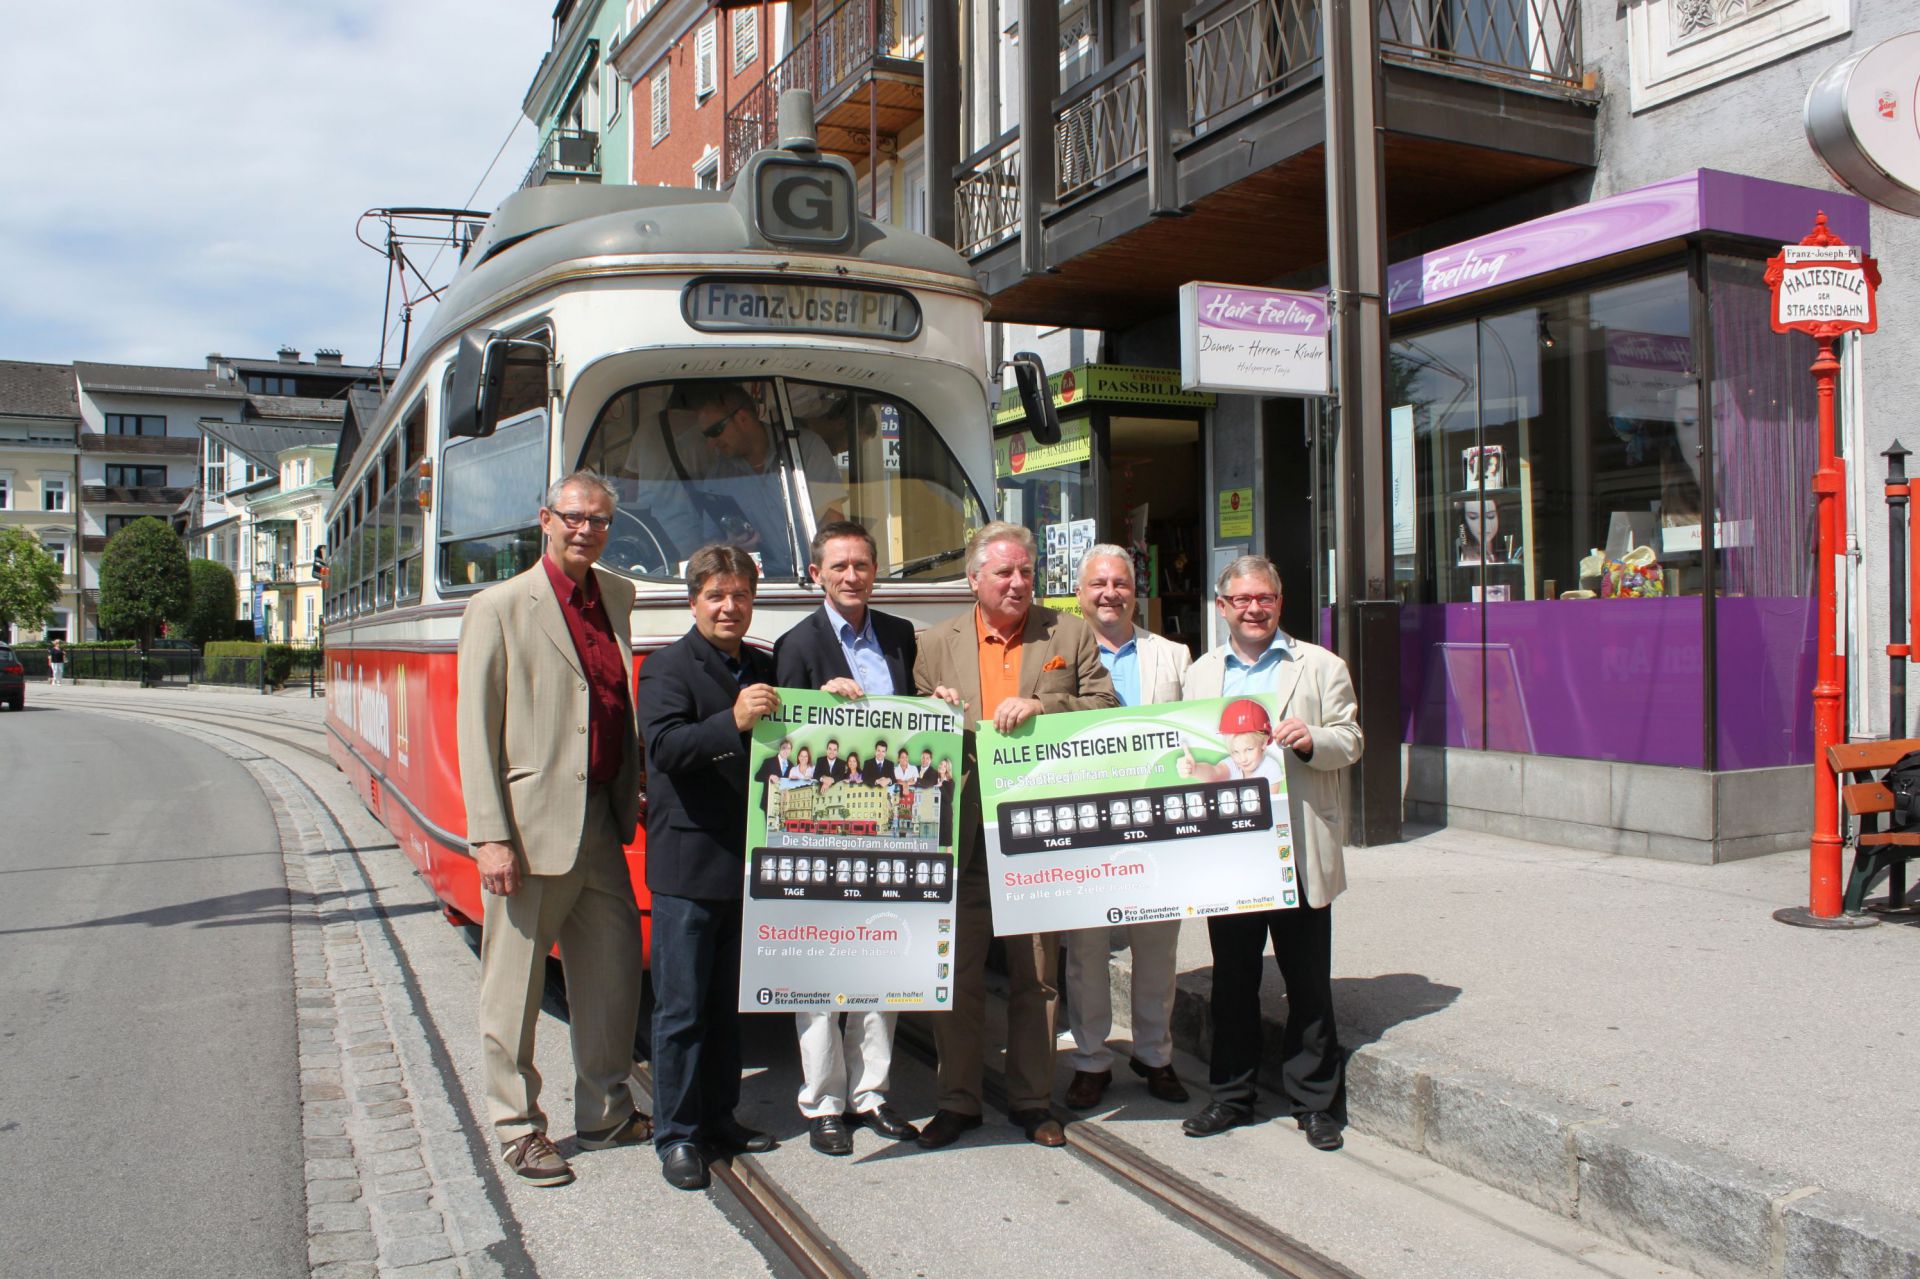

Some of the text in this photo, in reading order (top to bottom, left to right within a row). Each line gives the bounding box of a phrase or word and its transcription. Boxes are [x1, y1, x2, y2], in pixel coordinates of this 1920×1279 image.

[772, 176, 834, 232] G
[1417, 249, 1507, 300] Feeling
[1784, 269, 1865, 296] HALTESTELLE
[707, 284, 784, 320] Franz
[788, 289, 858, 323] Josef
[1817, 292, 1831, 301] DER
[1205, 293, 1317, 332] Hair Feeling
[1786, 304, 1863, 317] STRASSENBAHN
[1199, 335, 1235, 352] Damen
[1246, 340, 1281, 358] Herren
[1293, 343, 1324, 360] Kinder
[761, 704, 956, 733] ALLE EINSTEIGEN BITTE!
[993, 730, 1181, 766] ALLE EINSTEIGEN BITTE!
[994, 763, 1165, 789] Die StadtRegioTram kommt in
[782, 835, 928, 851] Die StadtRegioTram kommt in
[1043, 819, 1256, 848] TAGE STD. MIN. SEK.
[1004, 863, 1145, 888] StadtRegioTram
[783, 887, 940, 899] TAGE STD. MIN. SEK.
[1029, 889, 1050, 900] alle
[1055, 887, 1073, 897] die
[1124, 911, 1182, 922] Straßenbahn
[1139, 905, 1180, 915] Gmundner
[1196, 906, 1229, 915] VERKEHR
[758, 925, 898, 944] StadtRegioTram
[757, 945, 777, 957] Für
[780, 946, 802, 957] alle
[807, 945, 825, 957] die
[828, 946, 857, 957] Ziele
[774, 997, 832, 1005] Straßenbahn
[846, 997, 880, 1005] VERKEHR
